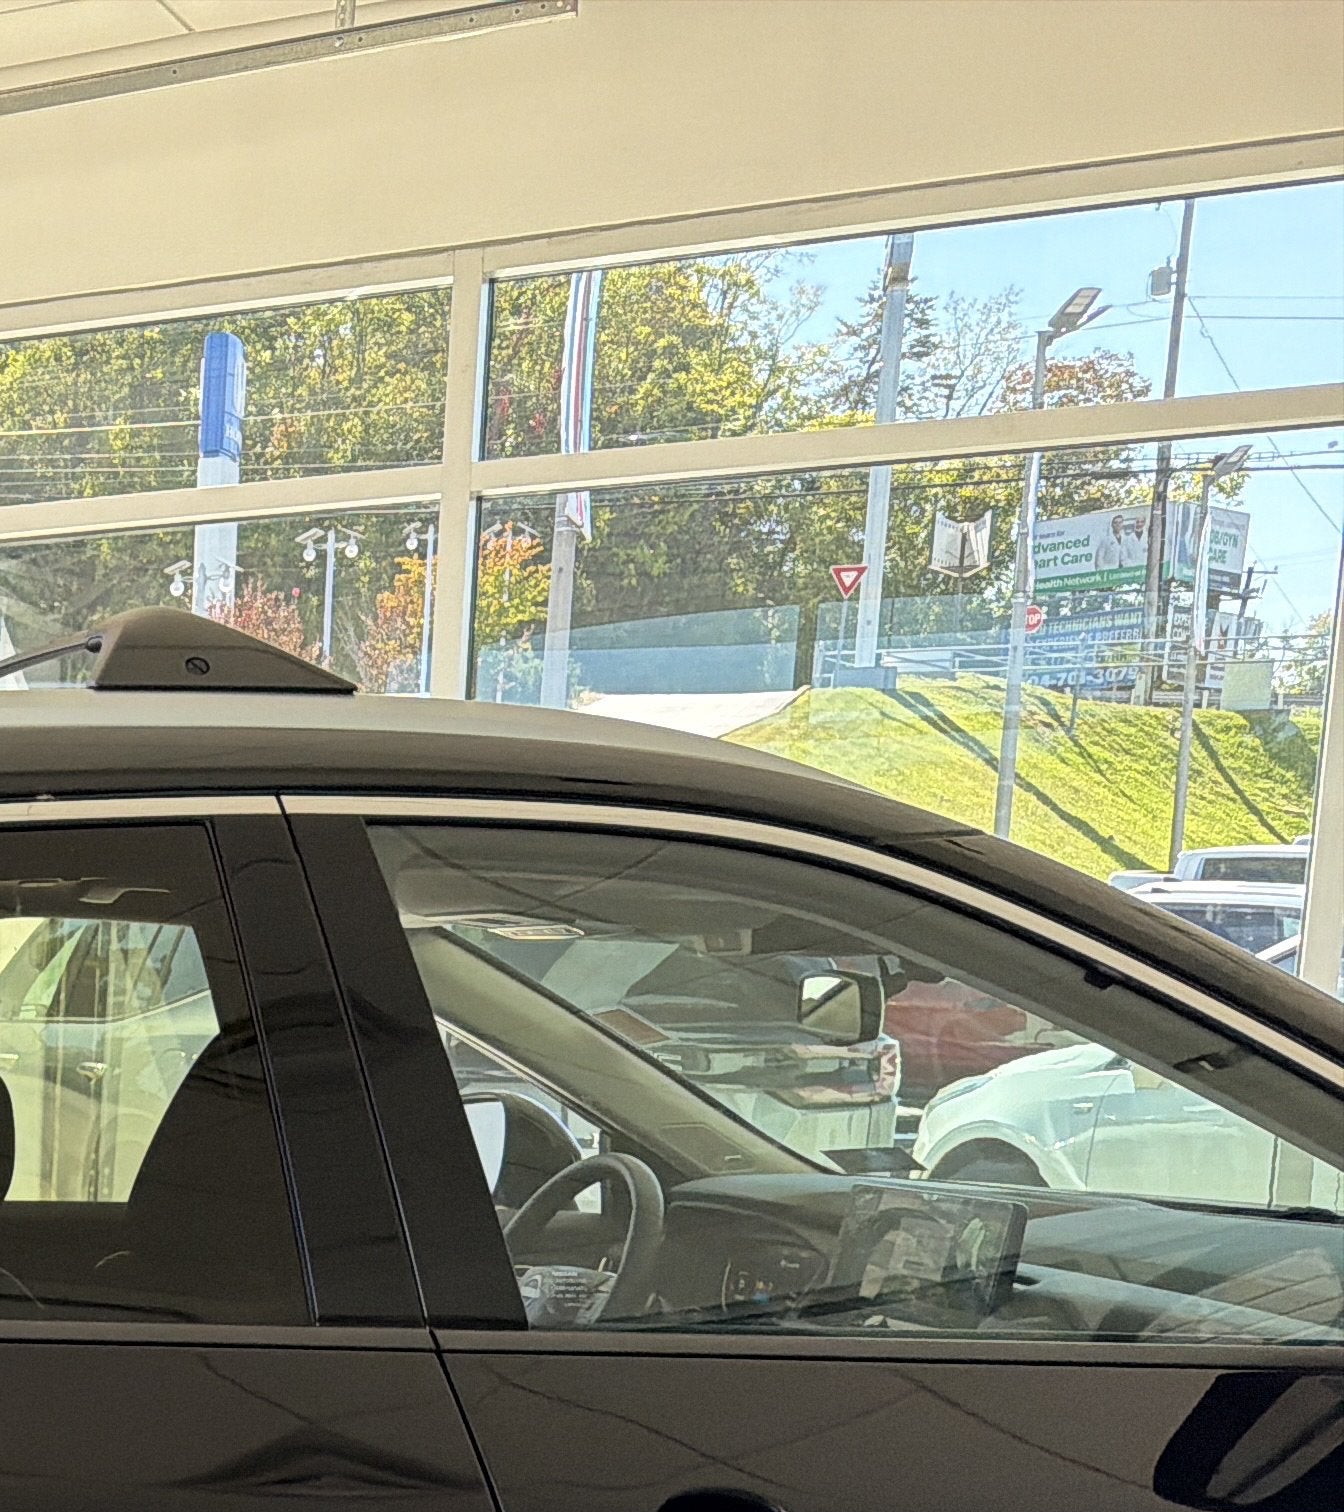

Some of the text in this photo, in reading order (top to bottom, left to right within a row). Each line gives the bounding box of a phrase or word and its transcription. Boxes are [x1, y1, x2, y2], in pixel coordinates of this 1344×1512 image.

[1032, 534, 1090, 554] dvanced
[1034, 552, 1093, 568] art Care
[1063, 573, 1103, 586] Network
[1026, 613, 1041, 625] TOP
[1114, 612, 1144, 626] WANT
[1029, 667, 1139, 687] 04-701-3079
